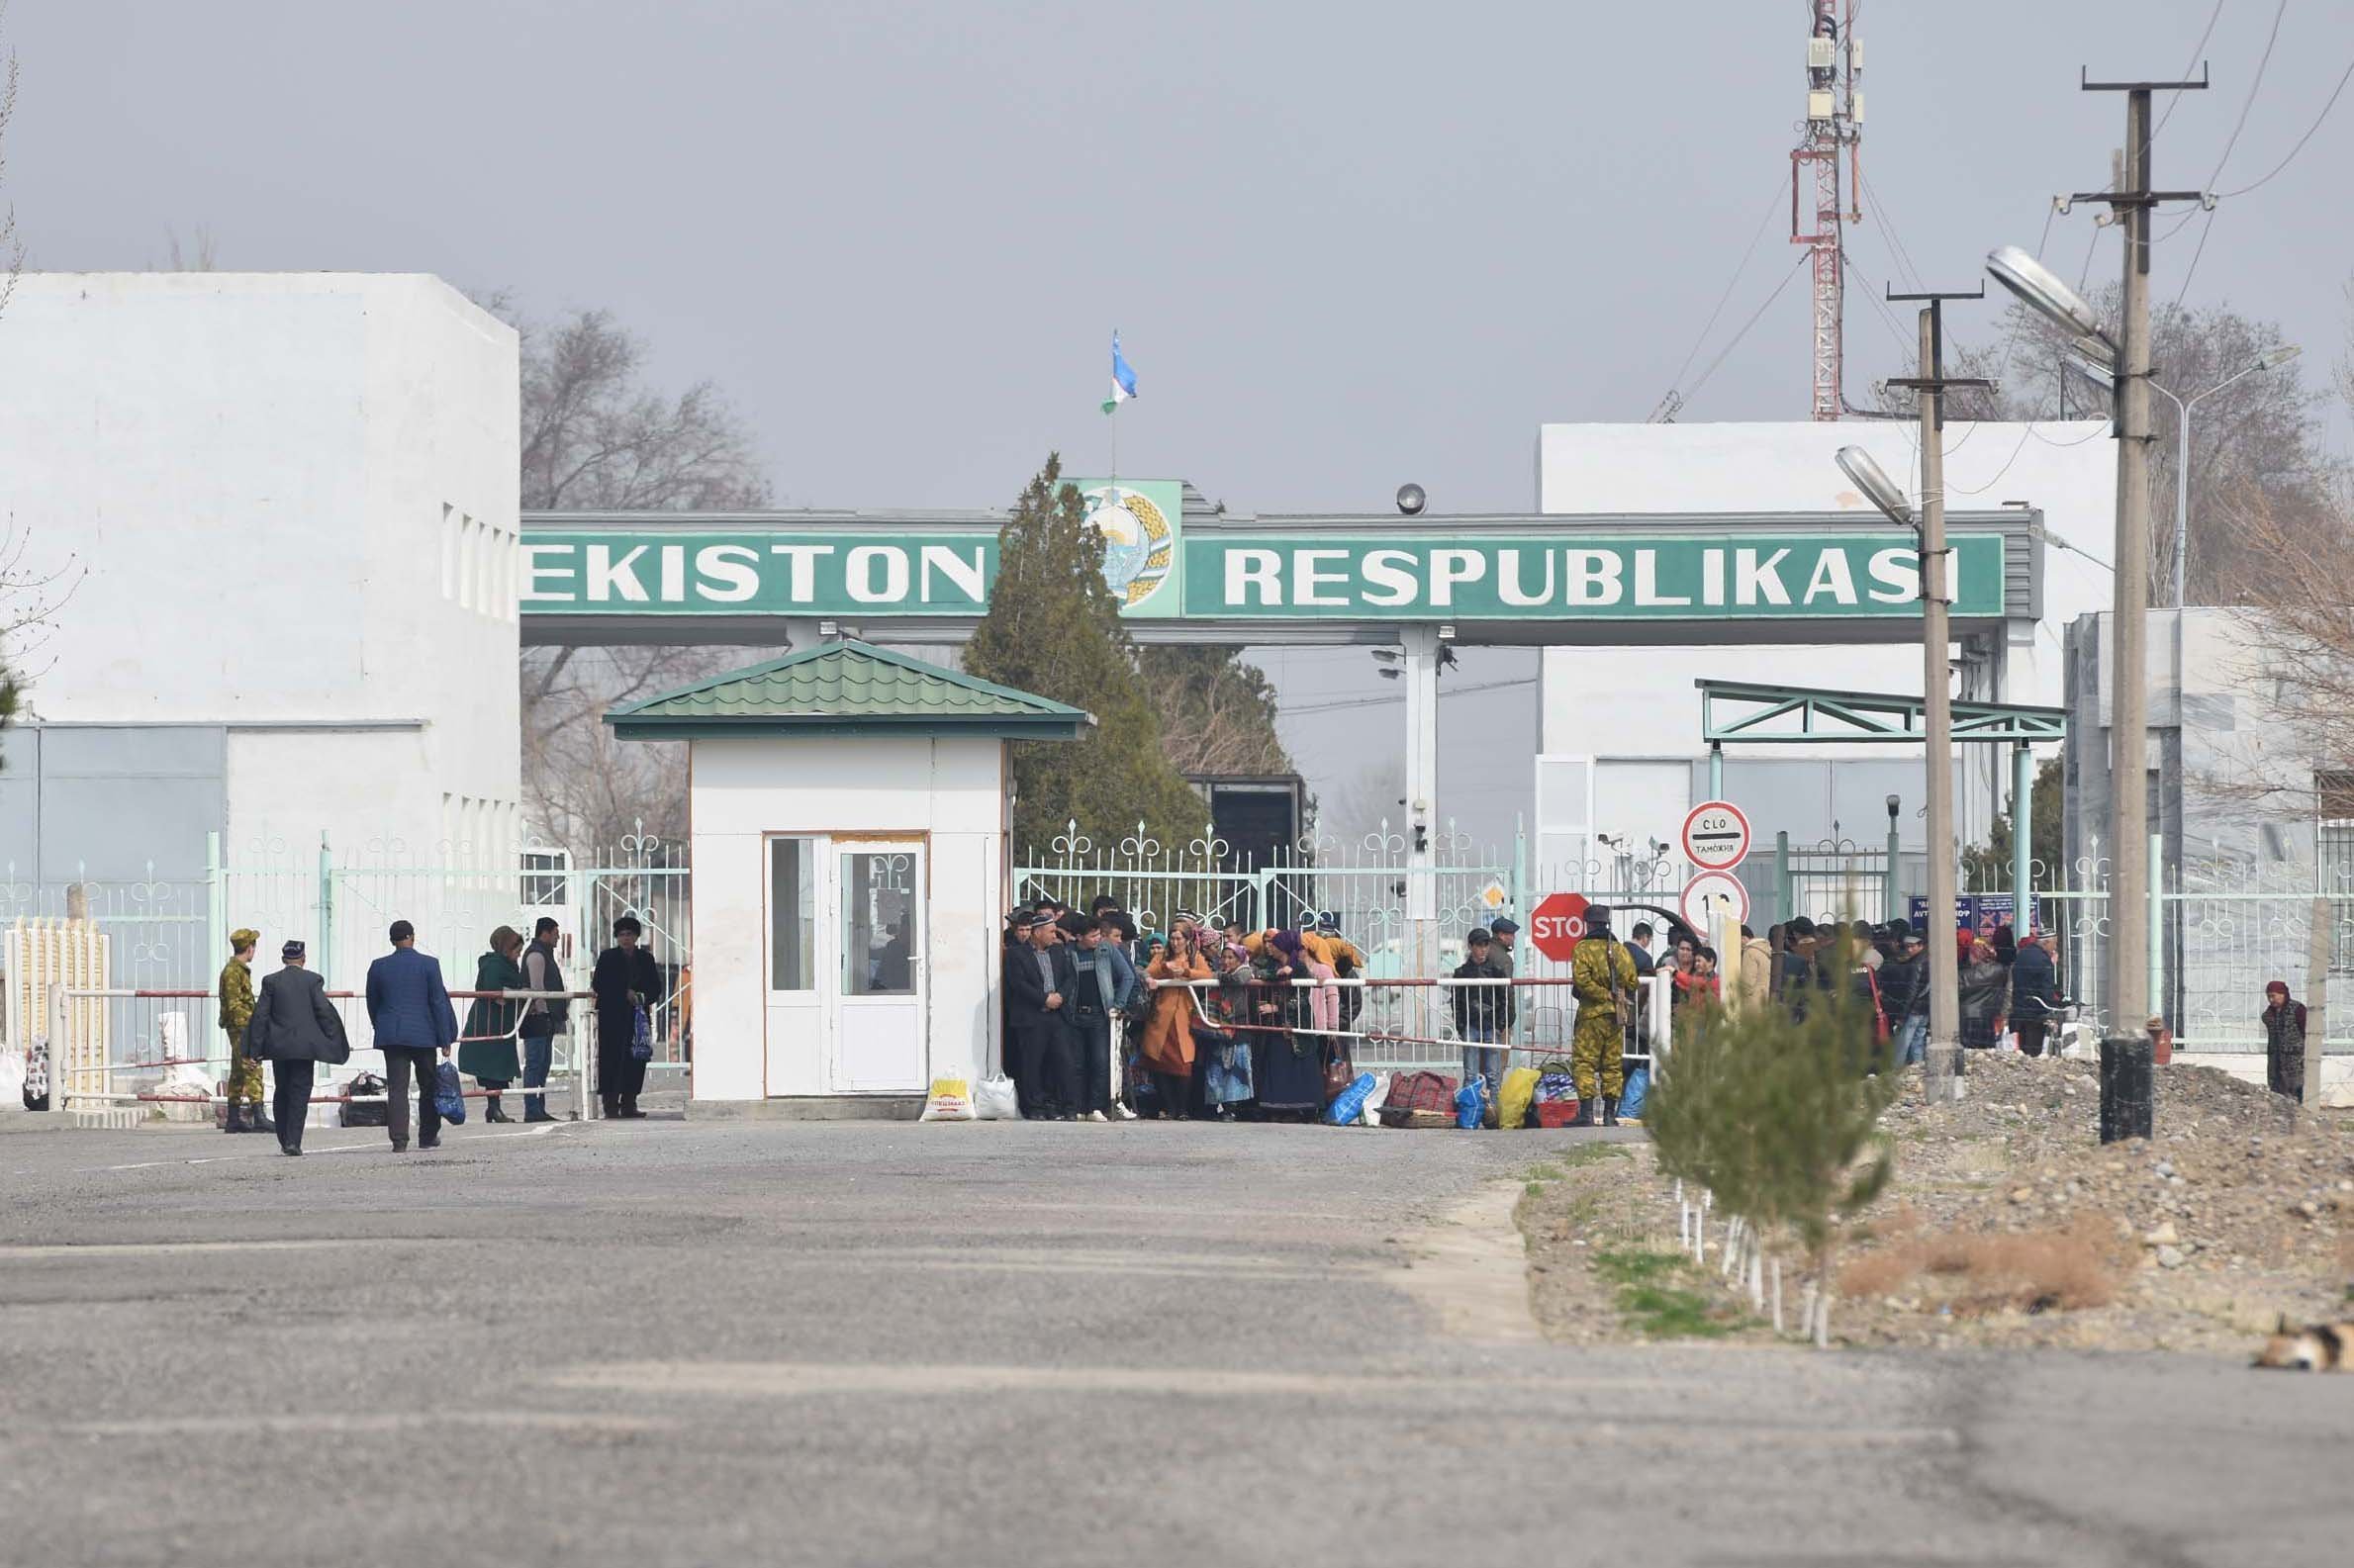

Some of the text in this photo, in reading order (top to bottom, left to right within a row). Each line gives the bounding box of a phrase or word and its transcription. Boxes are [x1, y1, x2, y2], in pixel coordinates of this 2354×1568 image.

[518, 544, 1958, 605] EKISTON RESPUBLIKASI
[1534, 915, 1588, 939] STO
